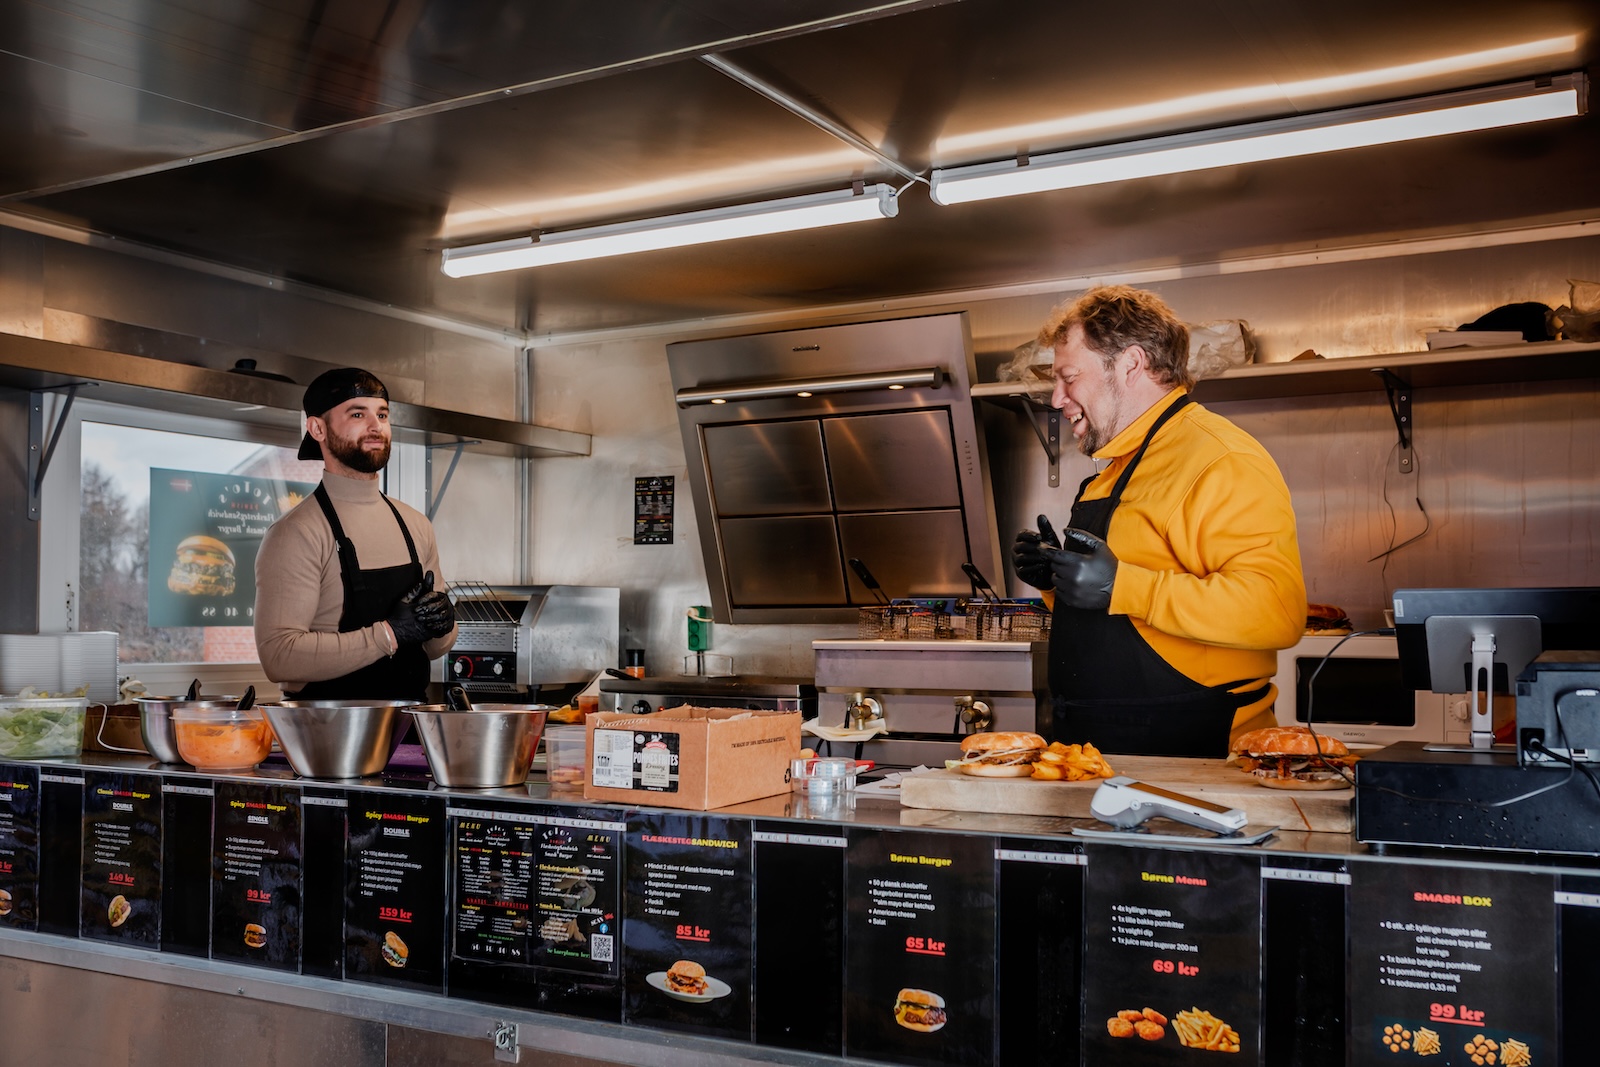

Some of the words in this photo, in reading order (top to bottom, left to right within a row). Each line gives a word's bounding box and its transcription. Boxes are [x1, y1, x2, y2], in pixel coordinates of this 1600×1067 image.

[658, 753, 679, 766] FRITES
[112, 802, 133, 810] DOUBLE
[230, 800, 246, 809] Spicy
[267, 803, 287, 812] Burger
[247, 815, 269, 823] SINGLE
[365, 811, 382, 820] Spicy
[383, 813, 406, 821] SMASH
[407, 815, 430, 824] Burger
[383, 827, 410, 836] DOUBLE
[586, 834, 611, 843] MENU
[889, 853, 918, 864] Børne
[919, 856, 953, 867] Burger
[109, 872, 123, 881] 149
[125, 873, 135, 882] kr
[1141, 871, 1174, 884] Børne
[1175, 875, 1207, 886] Menu
[884, 880, 900, 888] dansk
[247, 889, 258, 898] 99
[260, 890, 271, 899] kr
[873, 889, 903, 898] Burgerboller
[1414, 892, 1461, 904] SMASH
[1462, 895, 1492, 907] BOX
[887, 900, 902, 908] mayo
[914, 902, 935, 911] ketchup
[1125, 905, 1148, 916] kyllinge
[1148, 908, 1171, 918] nuggets
[380, 906, 398, 917] 159
[400, 908, 412, 919] kr
[873, 908, 897, 917] American
[897, 910, 916, 919] cheese
[873, 918, 886, 926] Salat
[1117, 915, 1125, 923] 1x
[1136, 917, 1154, 926] bakke
[676, 924, 692, 936] 85
[694, 925, 710, 938] kr
[1143, 929, 1153, 937] dip
[1385, 921, 1392, 929] 6
[1415, 923, 1441, 934] kyllinge
[1441, 927, 1470, 937] nuggets
[1470, 929, 1487, 938] eller
[906, 936, 924, 949] 65
[927, 937, 946, 951] kr
[1117, 936, 1125, 944] 1x
[1125, 937, 1139, 946] juice
[1139, 939, 1153, 948] med
[1176, 943, 1189, 951] 200
[1415, 935, 1431, 944] chili
[1431, 937, 1457, 947] cheese
[1457, 939, 1475, 948] tops
[1474, 941, 1492, 950] eller
[1415, 946, 1429, 955] hot
[1428, 947, 1450, 958] wings
[1152, 959, 1175, 974] 69
[1177, 961, 1200, 977] kr
[1387, 955, 1395, 963] 1x
[1395, 955, 1416, 965] bakke
[1416, 958, 1445, 969] belgiske
[1445, 961, 1482, 972] pomfritter
[1387, 966, 1395, 974] 1x
[1395, 967, 1430, 978] pomfritter
[1430, 972, 1460, 983] dressing
[1387, 978, 1395, 986] 1x
[1395, 979, 1429, 990] sodavand
[1429, 1002, 1456, 1018] 99
[1459, 1004, 1485, 1021] kr
